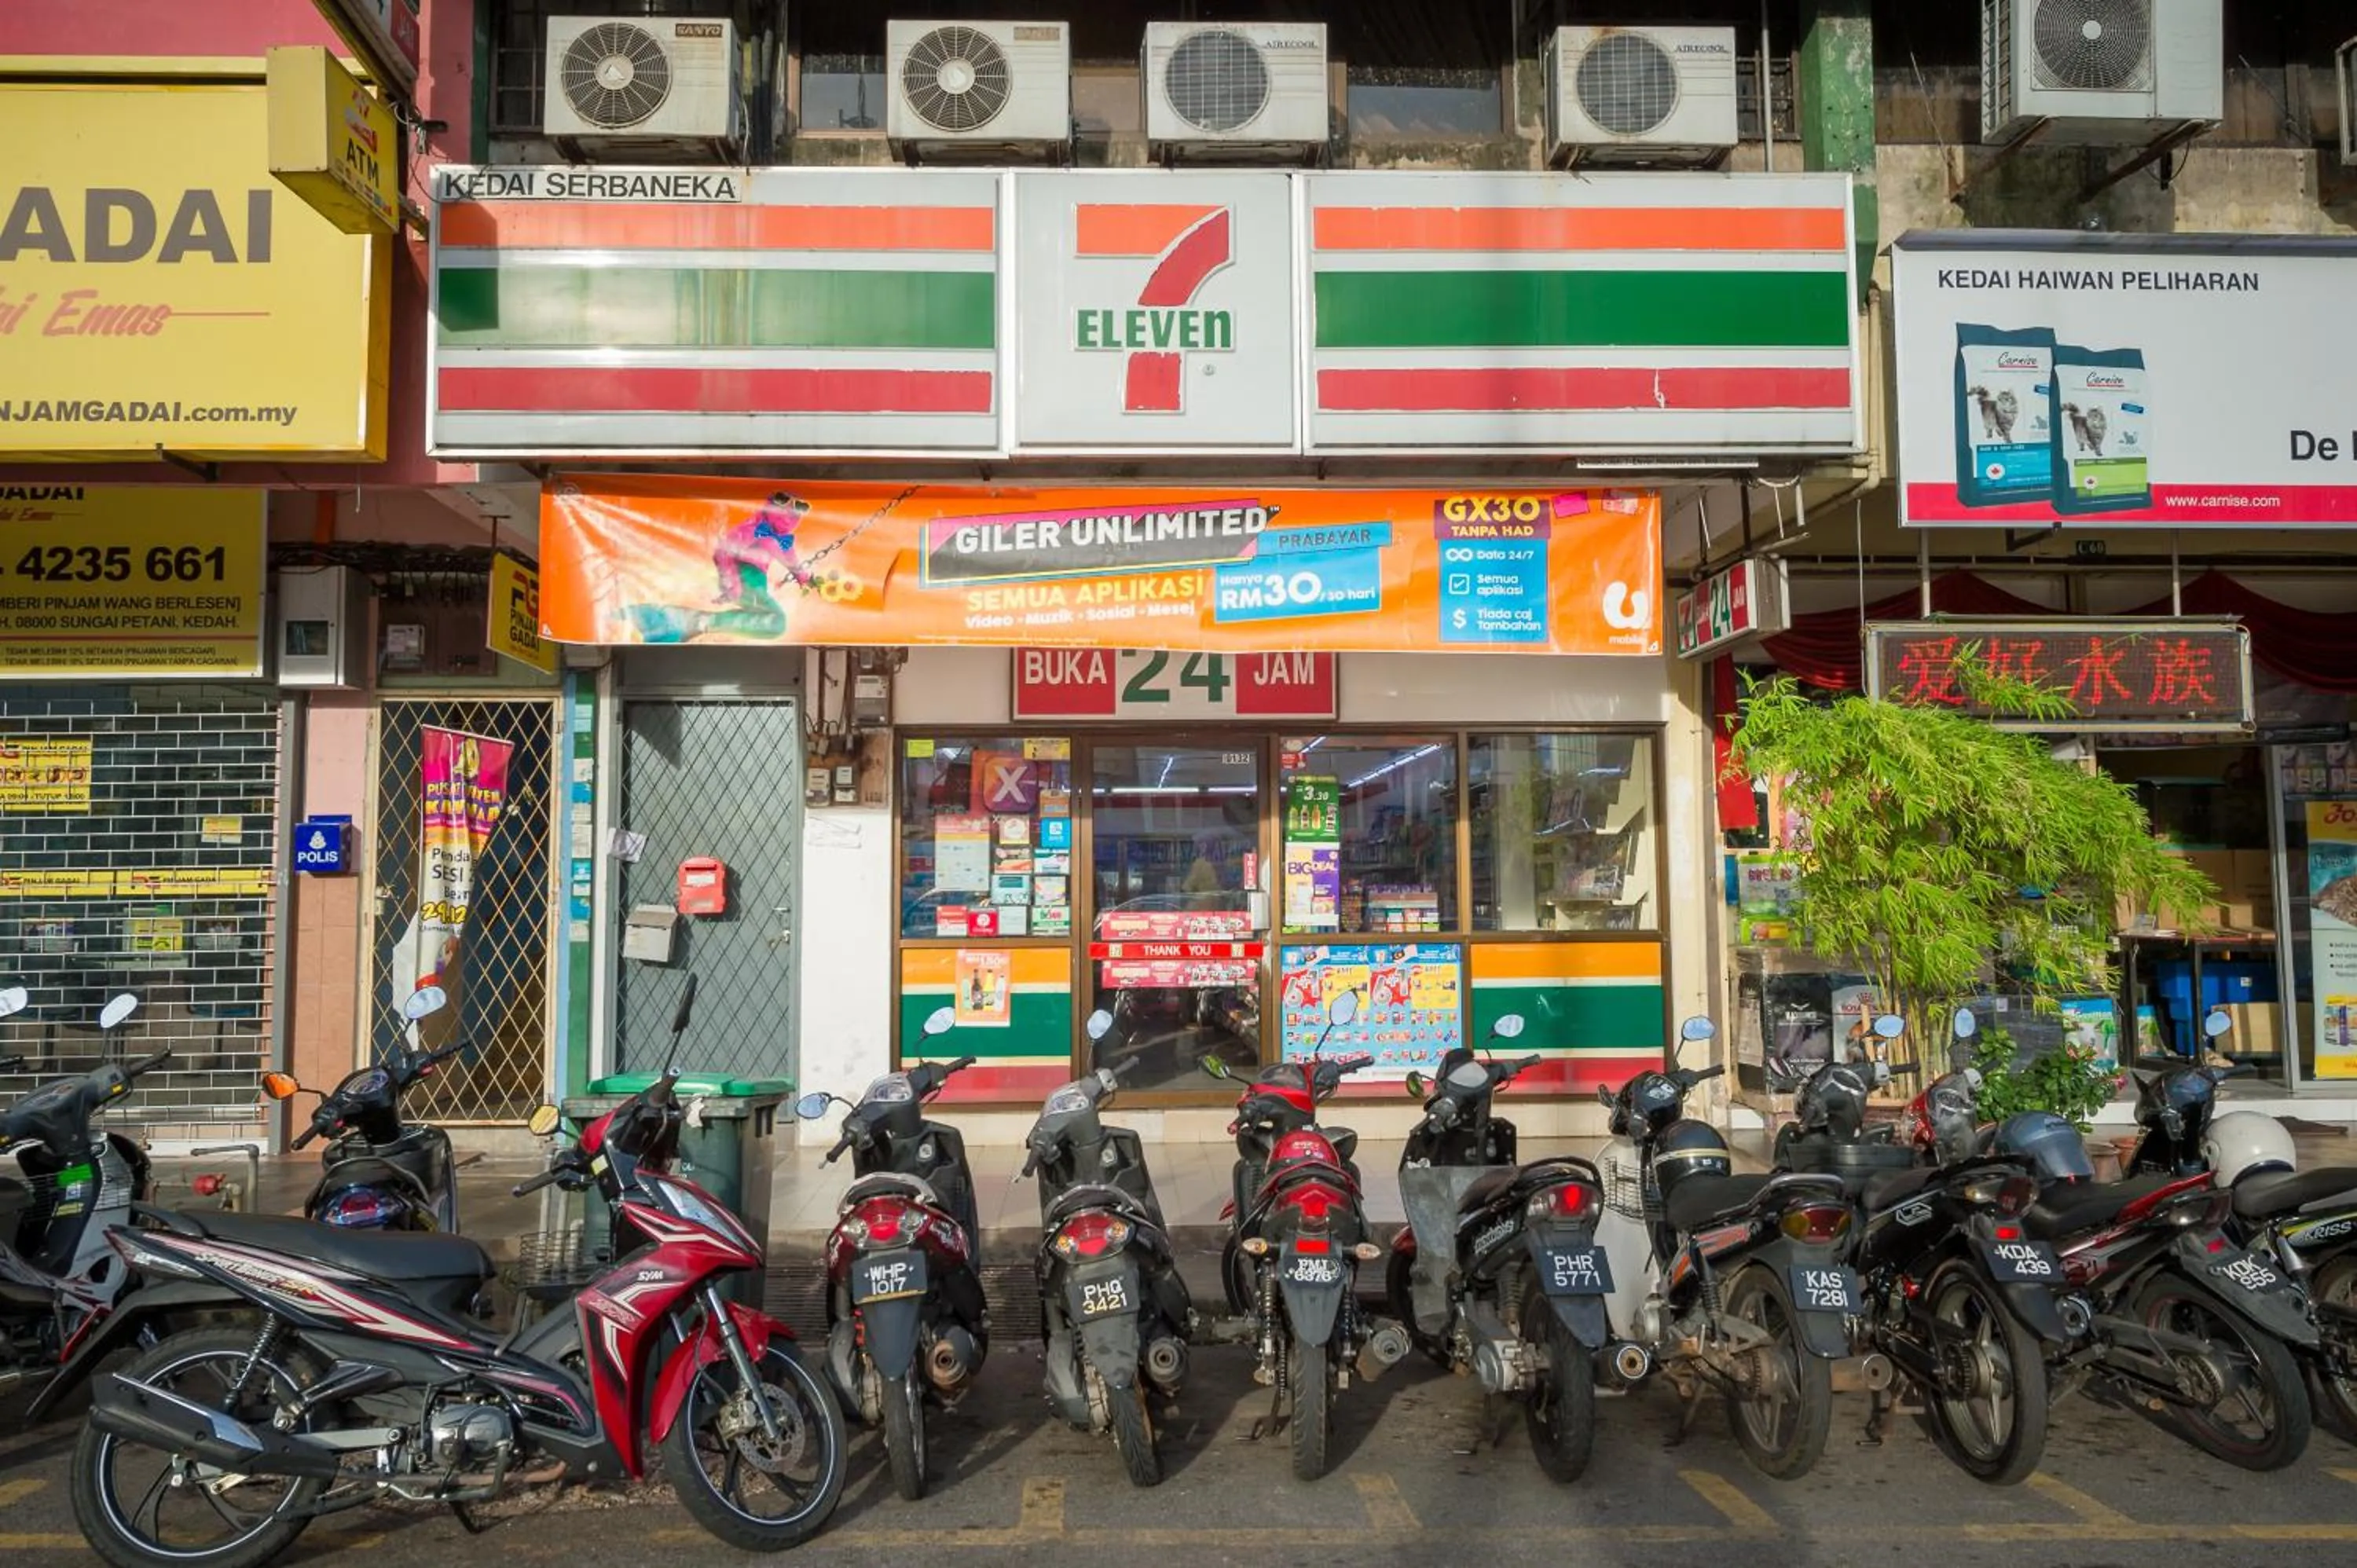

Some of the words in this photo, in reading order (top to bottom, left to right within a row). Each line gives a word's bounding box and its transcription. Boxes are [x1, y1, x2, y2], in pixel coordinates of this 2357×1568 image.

[1265, 39, 1319, 49] AIRECOOL
[1674, 44, 1728, 53] AIRECOOL
[346, 137, 379, 188] ATM
[445, 173, 534, 197] KEDAI
[545, 173, 736, 199] SERBANEKA
[1937, 270, 2011, 289] KEDAI
[2018, 270, 2113, 290] HAIWAN
[2121, 271, 2260, 291] PELIHARAN
[42, 290, 173, 335] Emas
[2289, 430, 2339, 461] De
[1443, 496, 1541, 522] GX30
[955, 520, 1061, 555] GILER
[1070, 506, 1268, 546] UNLIMITED
[1278, 529, 1372, 548] PRABAYAR
[1451, 526, 1497, 537] TANPA
[1502, 525, 1534, 537] HAD
[16, 546, 131, 582] 4235
[145, 546, 225, 582] 661
[1476, 550, 1507, 560] Data
[1508, 550, 1534, 560] 24/7
[1220, 574, 1263, 588] Hanya
[1476, 573, 1519, 584] Semua
[966, 590, 1067, 612] SEMUA
[1076, 574, 1204, 605] APLIKASI
[1347, 586, 1376, 600] hari
[45, 597, 101, 610] PINJAM
[104, 597, 152, 610] WANG
[60, 616, 118, 628] SUNGAI
[965, 614, 1014, 629] Video
[1025, 610, 1075, 626] Muzik
[1086, 604, 1136, 621] Sosial
[1146, 600, 1195, 618] Mesej
[1515, 610, 1533, 622] caj
[1477, 620, 1541, 632] Tambahan
[1025, 650, 1108, 685] BUKA
[1122, 649, 1230, 702] 24
[1253, 651, 1315, 686] JAM
[297, 850, 339, 864] POLIS
[431, 864, 464, 882] SESI
[1143, 944, 1181, 956] THANK
[1188, 944, 1211, 956] YOU
[1998, 1244, 2039, 1260] KDA
[869, 1262, 907, 1281] WHP
[1554, 1255, 1595, 1270] PHR
[2014, 1260, 2051, 1275] 439
[2223, 1255, 2261, 1281] KDK
[636, 1270, 664, 1281] SYM
[1554, 1270, 1601, 1287] 5771
[1805, 1270, 1843, 1289] KAS
[871, 1277, 907, 1295] 1017
[1083, 1279, 1123, 1300] PHQ
[1082, 1291, 1127, 1314] 3421
[1805, 1288, 1849, 1307] 7281
